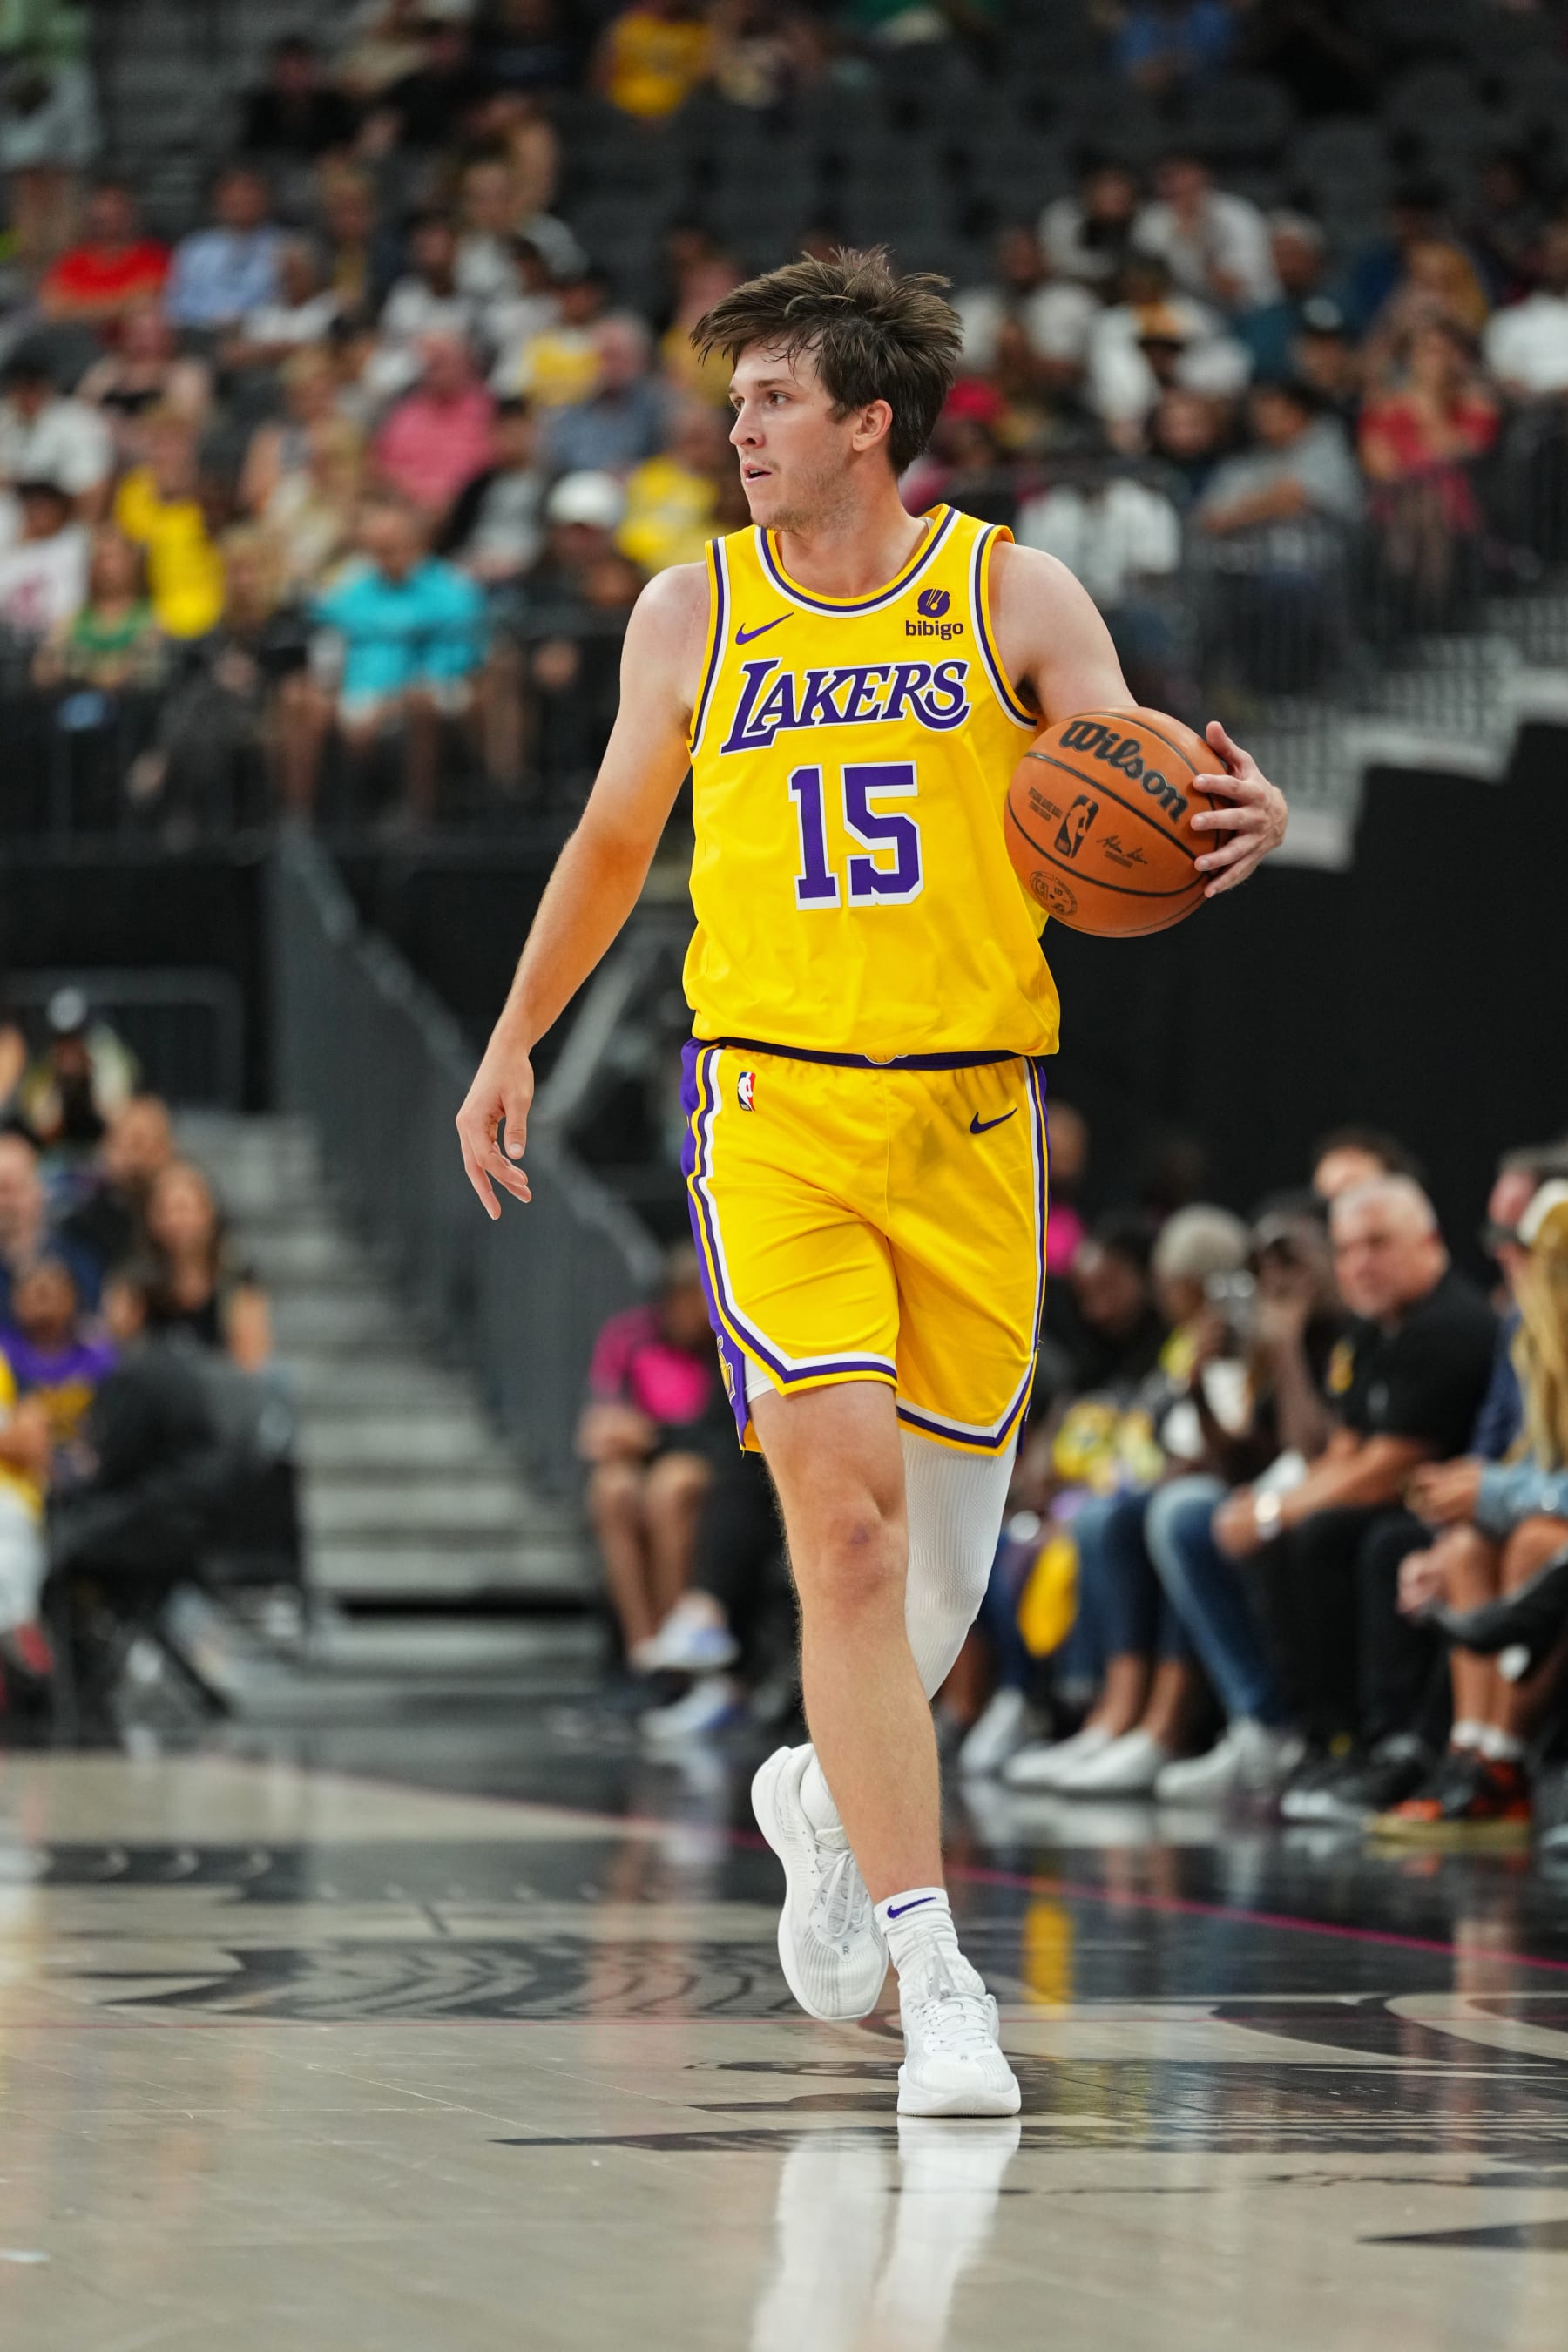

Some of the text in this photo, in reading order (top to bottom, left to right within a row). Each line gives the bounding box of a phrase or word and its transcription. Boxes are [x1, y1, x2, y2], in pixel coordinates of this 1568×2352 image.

[905, 619, 963, 641] bibigo
[720, 657, 971, 756] LAKERS
[1059, 720, 1188, 823] Wilson
[787, 760, 924, 911] 15
